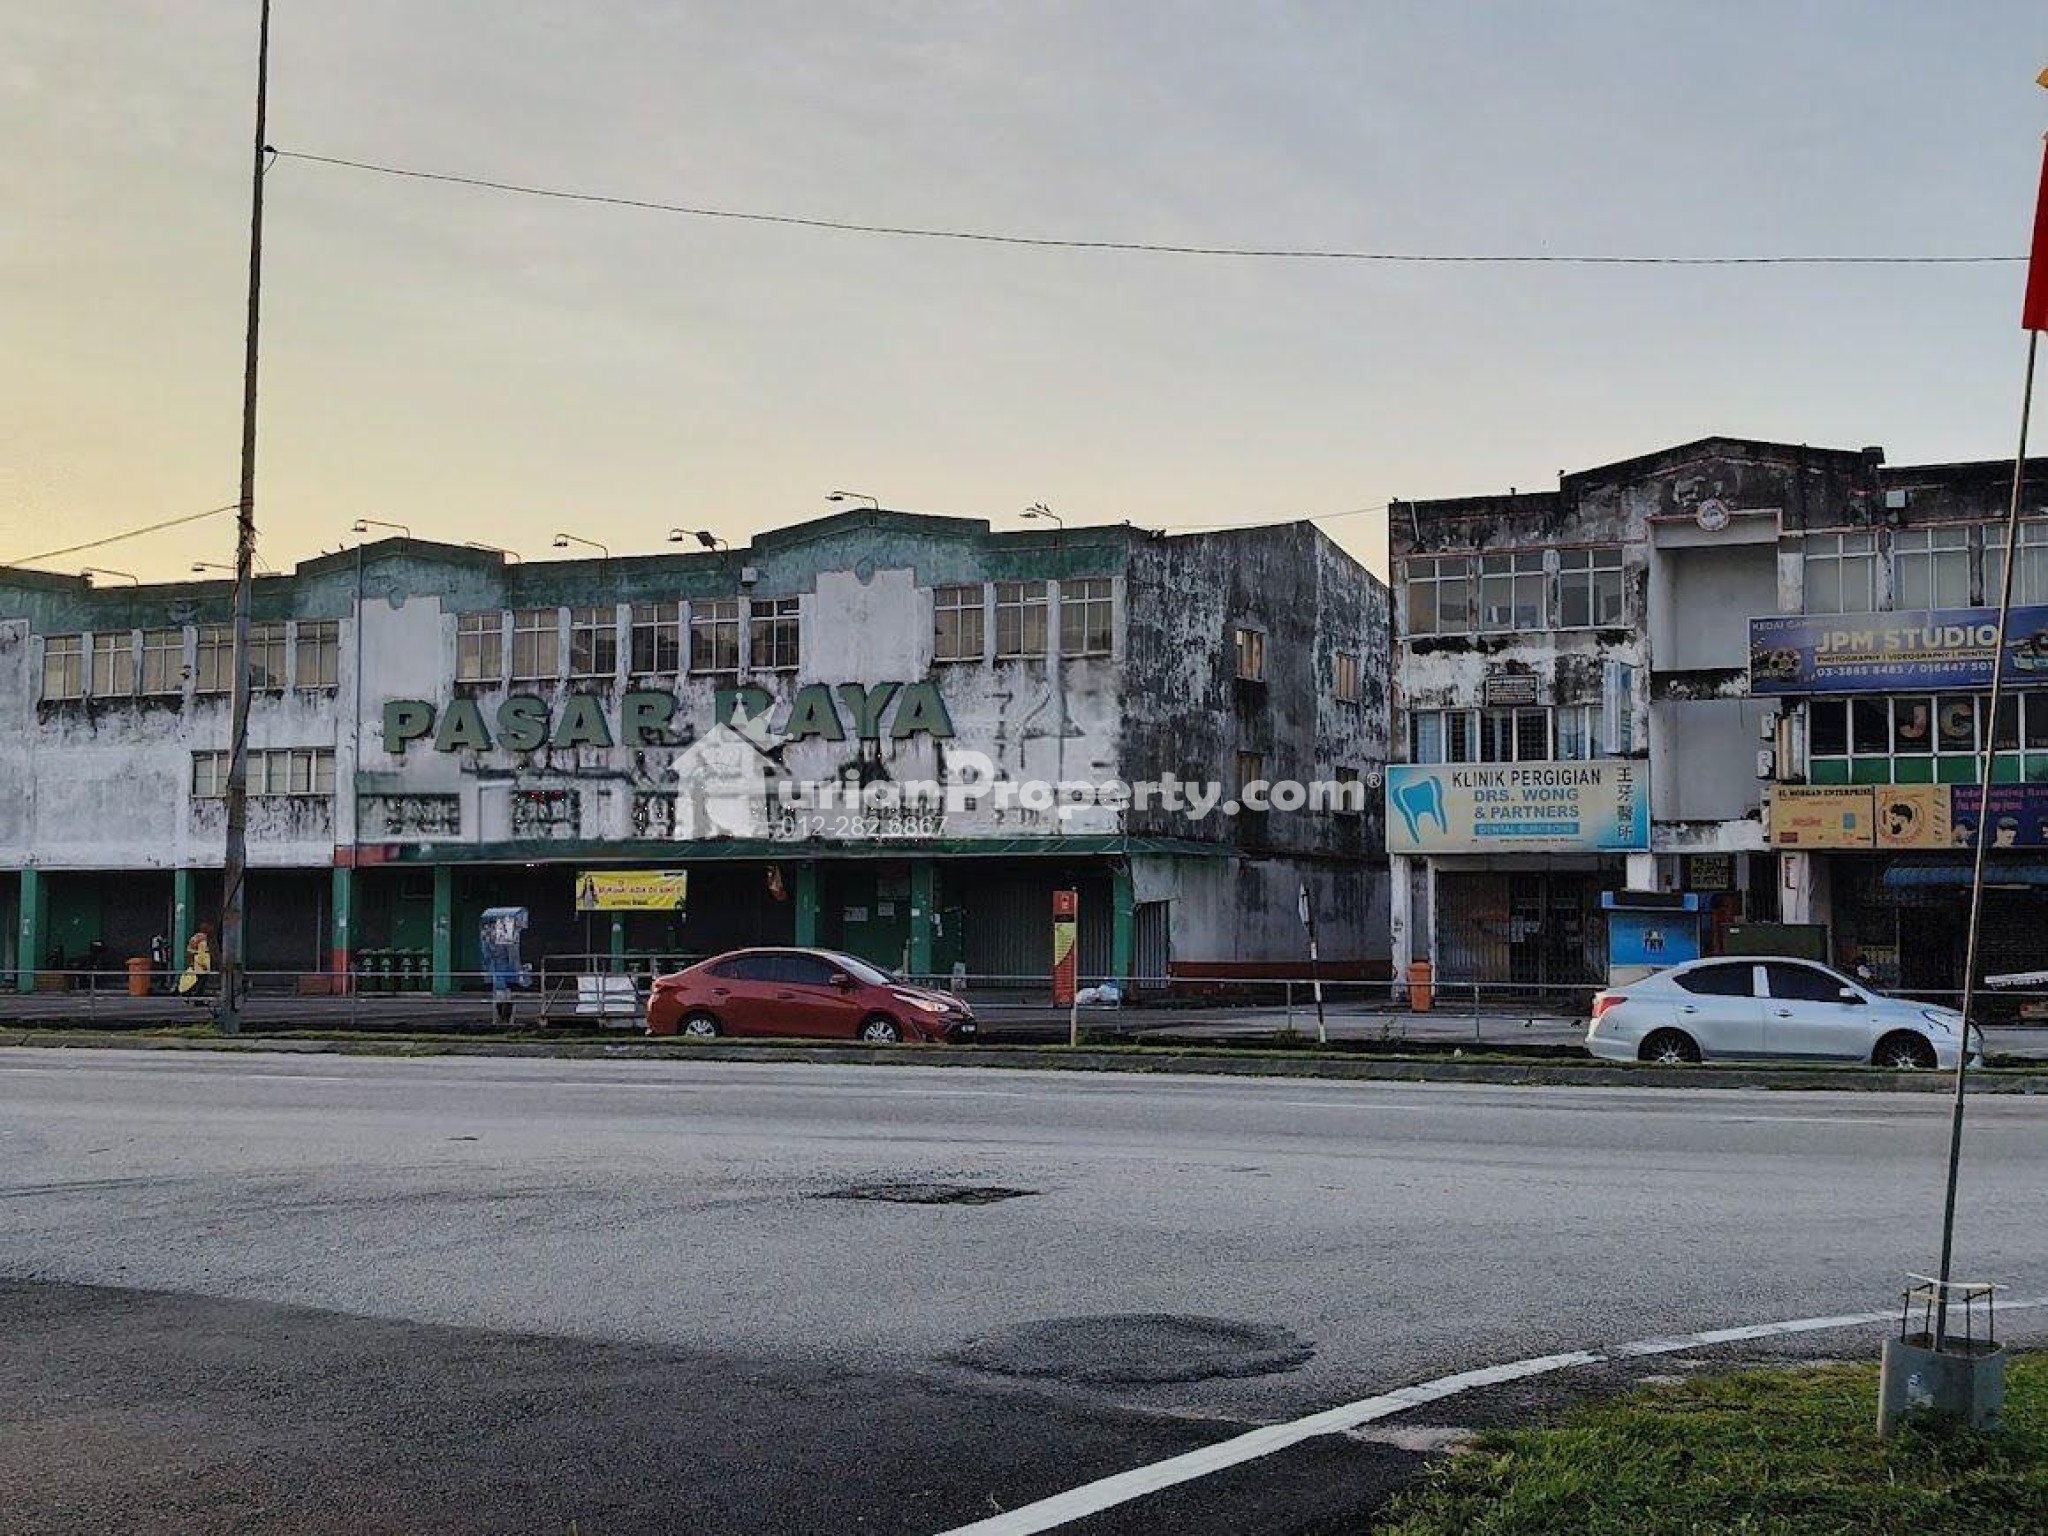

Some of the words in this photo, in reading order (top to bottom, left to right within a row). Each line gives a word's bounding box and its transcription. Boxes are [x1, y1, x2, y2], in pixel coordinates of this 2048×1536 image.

[1815, 630, 1874, 653] JPM
[1886, 624, 1999, 650] STUDIO
[1888, 651, 1950, 662] VIDEOGRAPHY
[383, 690, 694, 753] PASAR
[715, 682, 954, 742] RAYA
[1453, 771, 1506, 788] KLINIK
[1511, 768, 1601, 787] PERGIGIAN
[1474, 789, 1515, 802] DRS.
[1522, 787, 1580, 801] WONG
[1474, 807, 1485, 819] &
[1490, 805, 1580, 819] PARTNERS
